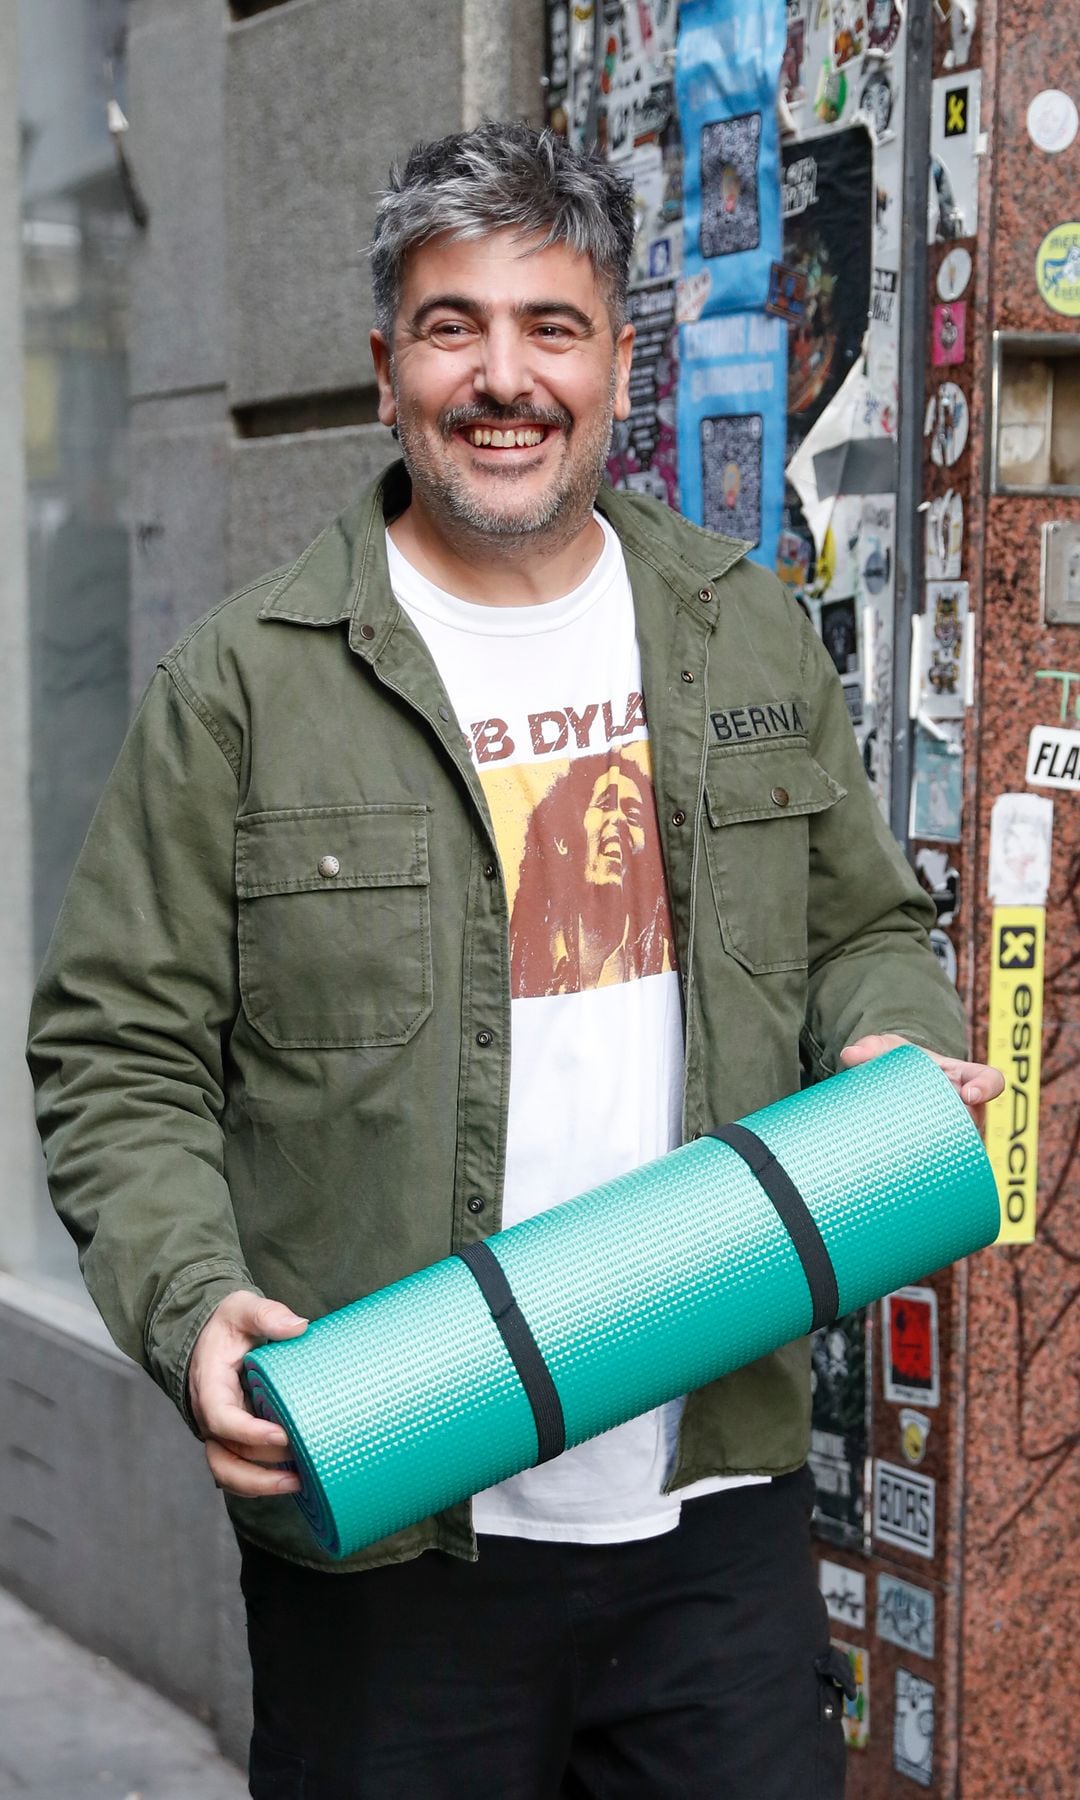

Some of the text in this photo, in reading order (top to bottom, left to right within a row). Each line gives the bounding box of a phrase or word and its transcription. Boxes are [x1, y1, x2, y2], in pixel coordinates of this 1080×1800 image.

[1035, 670, 1080, 721] T
[709, 703, 804, 740] BERNA
[1033, 741, 1080, 780] FLA
